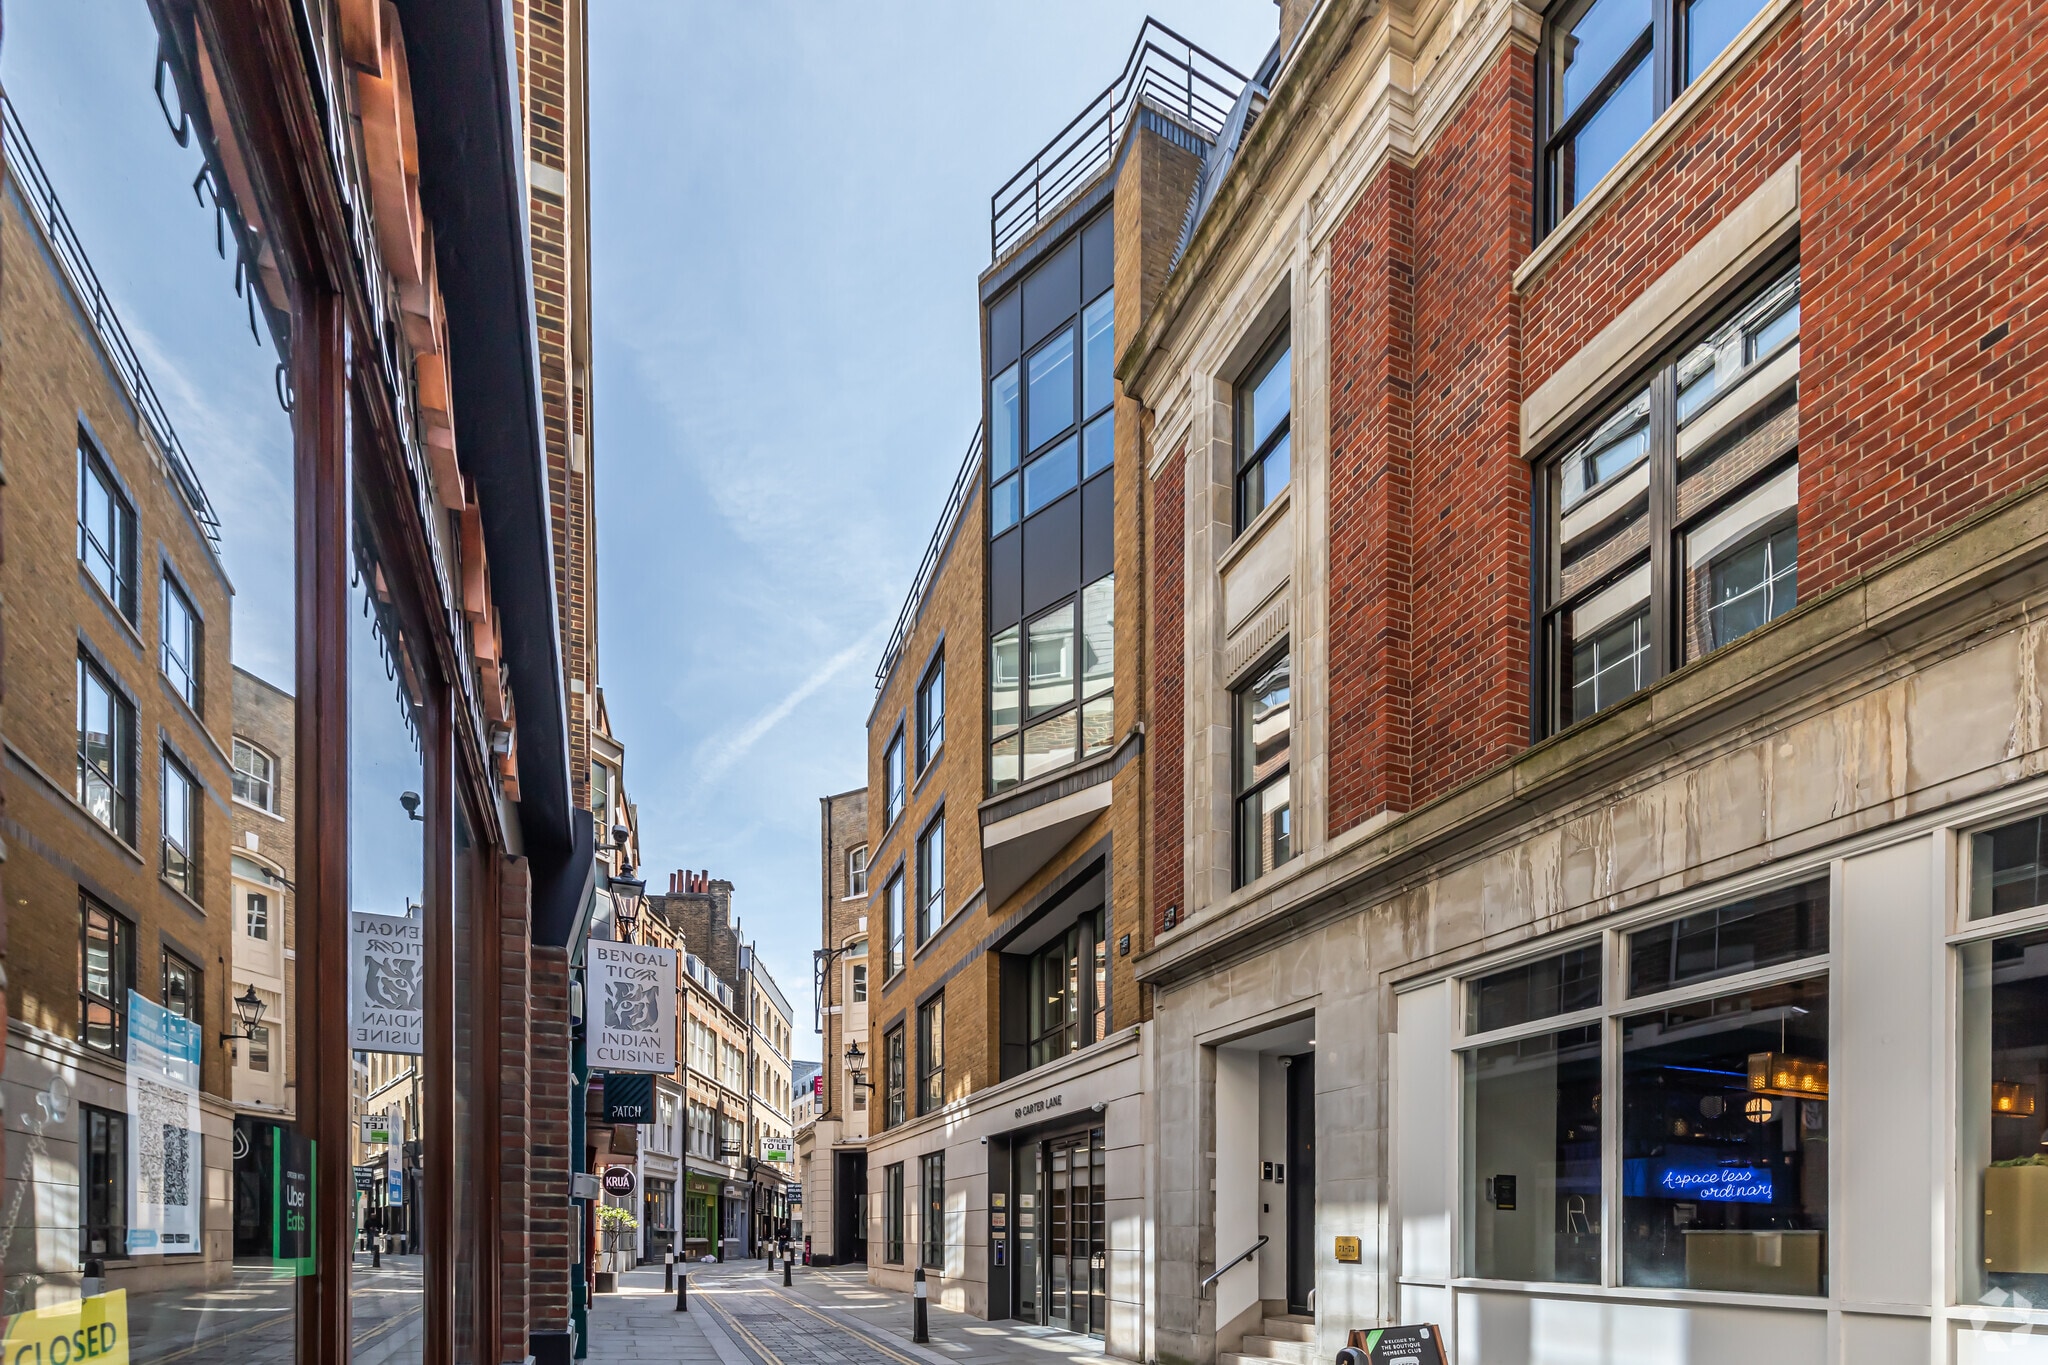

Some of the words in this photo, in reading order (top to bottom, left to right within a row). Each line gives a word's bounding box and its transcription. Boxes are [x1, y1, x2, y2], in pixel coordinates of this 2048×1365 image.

[596, 948, 668, 967] BENGAL
[602, 1032, 661, 1048] INDIAN
[597, 1047, 665, 1065] CUISINE
[612, 1105, 642, 1118] PATCH
[1022, 1101, 1044, 1116] CARTER
[1045, 1095, 1062, 1109] LANE
[1662, 1171, 1676, 1189] A
[1674, 1173, 1720, 1188] space
[1721, 1169, 1752, 1183] less
[286, 1185, 305, 1207] Uber
[1700, 1183, 1773, 1199] ordinary
[287, 1210, 305, 1231] Eats
[14, 1321, 117, 1365] CLOSED
